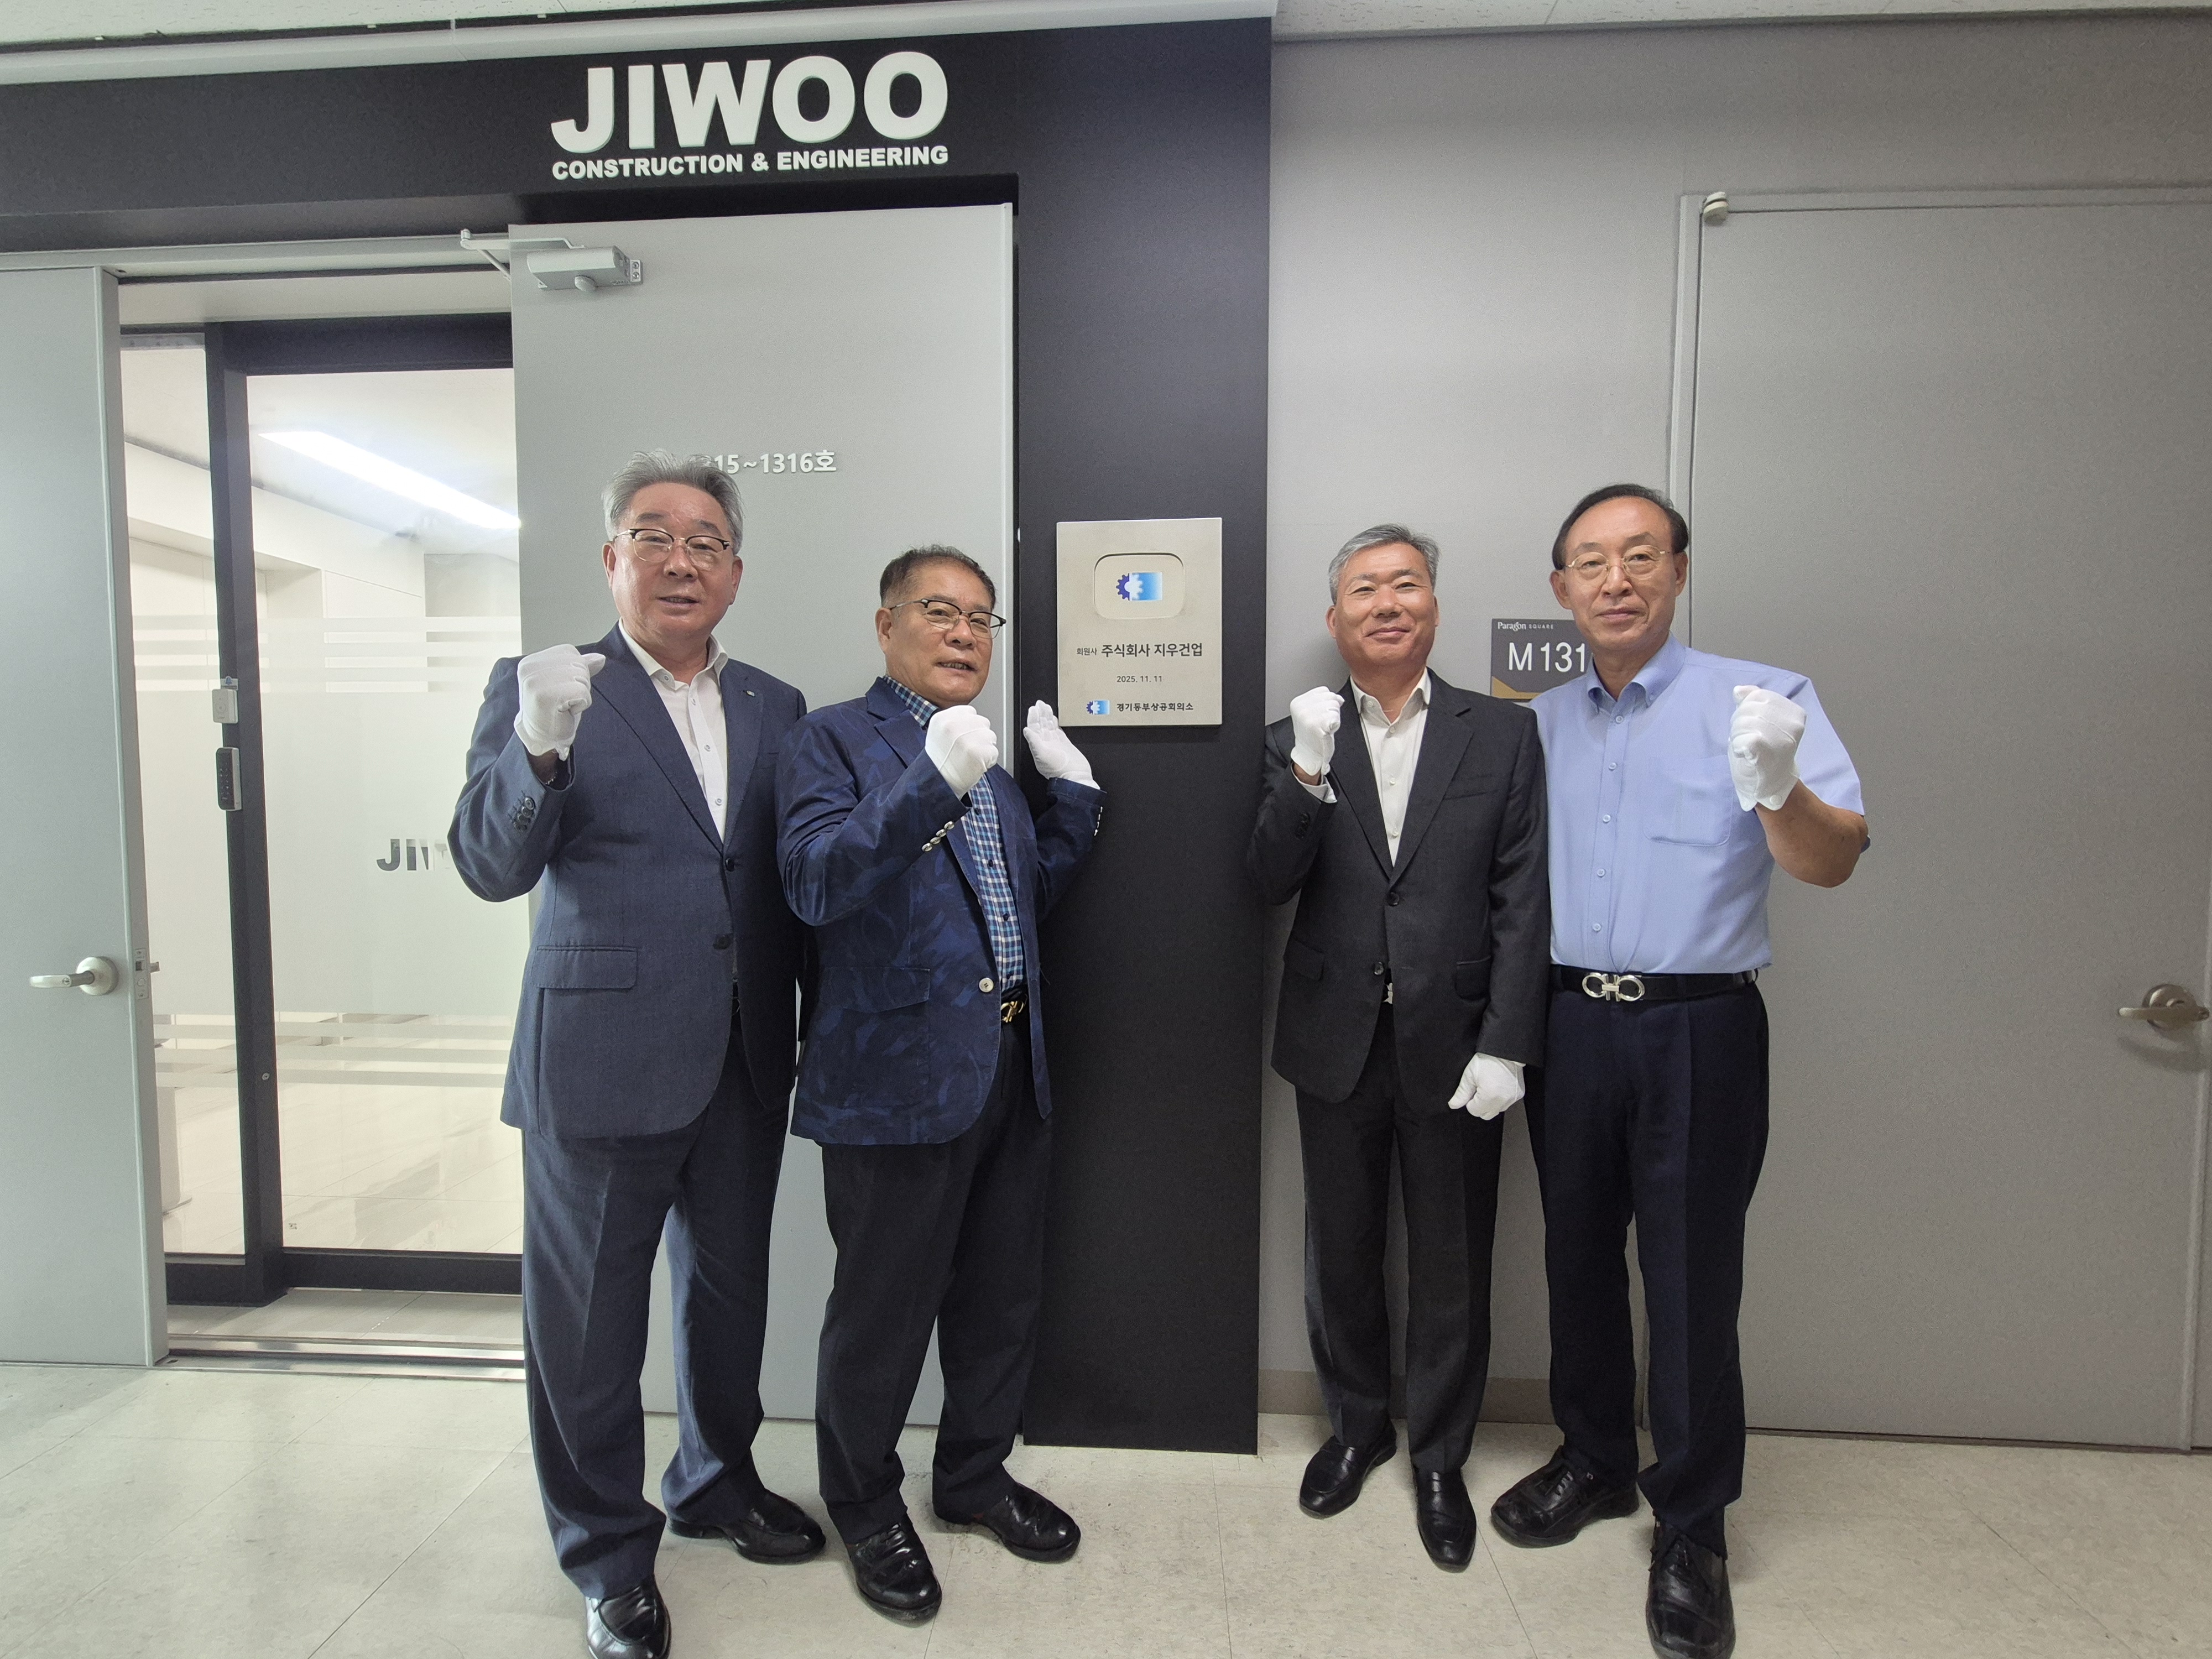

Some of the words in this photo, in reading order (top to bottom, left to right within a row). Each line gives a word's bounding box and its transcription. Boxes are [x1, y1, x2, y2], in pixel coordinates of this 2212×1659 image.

[551, 51, 948, 154] JIWOO
[552, 154, 743, 180] CONSTRUCTION
[751, 153, 770, 172] &
[776, 145, 949, 171] ENGINEERING
[713, 449, 837, 474] 15~1316호
[1498, 621, 1526, 632] Paragon
[1076, 647, 1098, 656] 회원사
[1101, 643, 1151, 657] 주식회사
[1154, 643, 1203, 657] 지우건업
[1540, 642, 1585, 672] 131
[1116, 702, 1194, 712] 경기동부상공회의소
